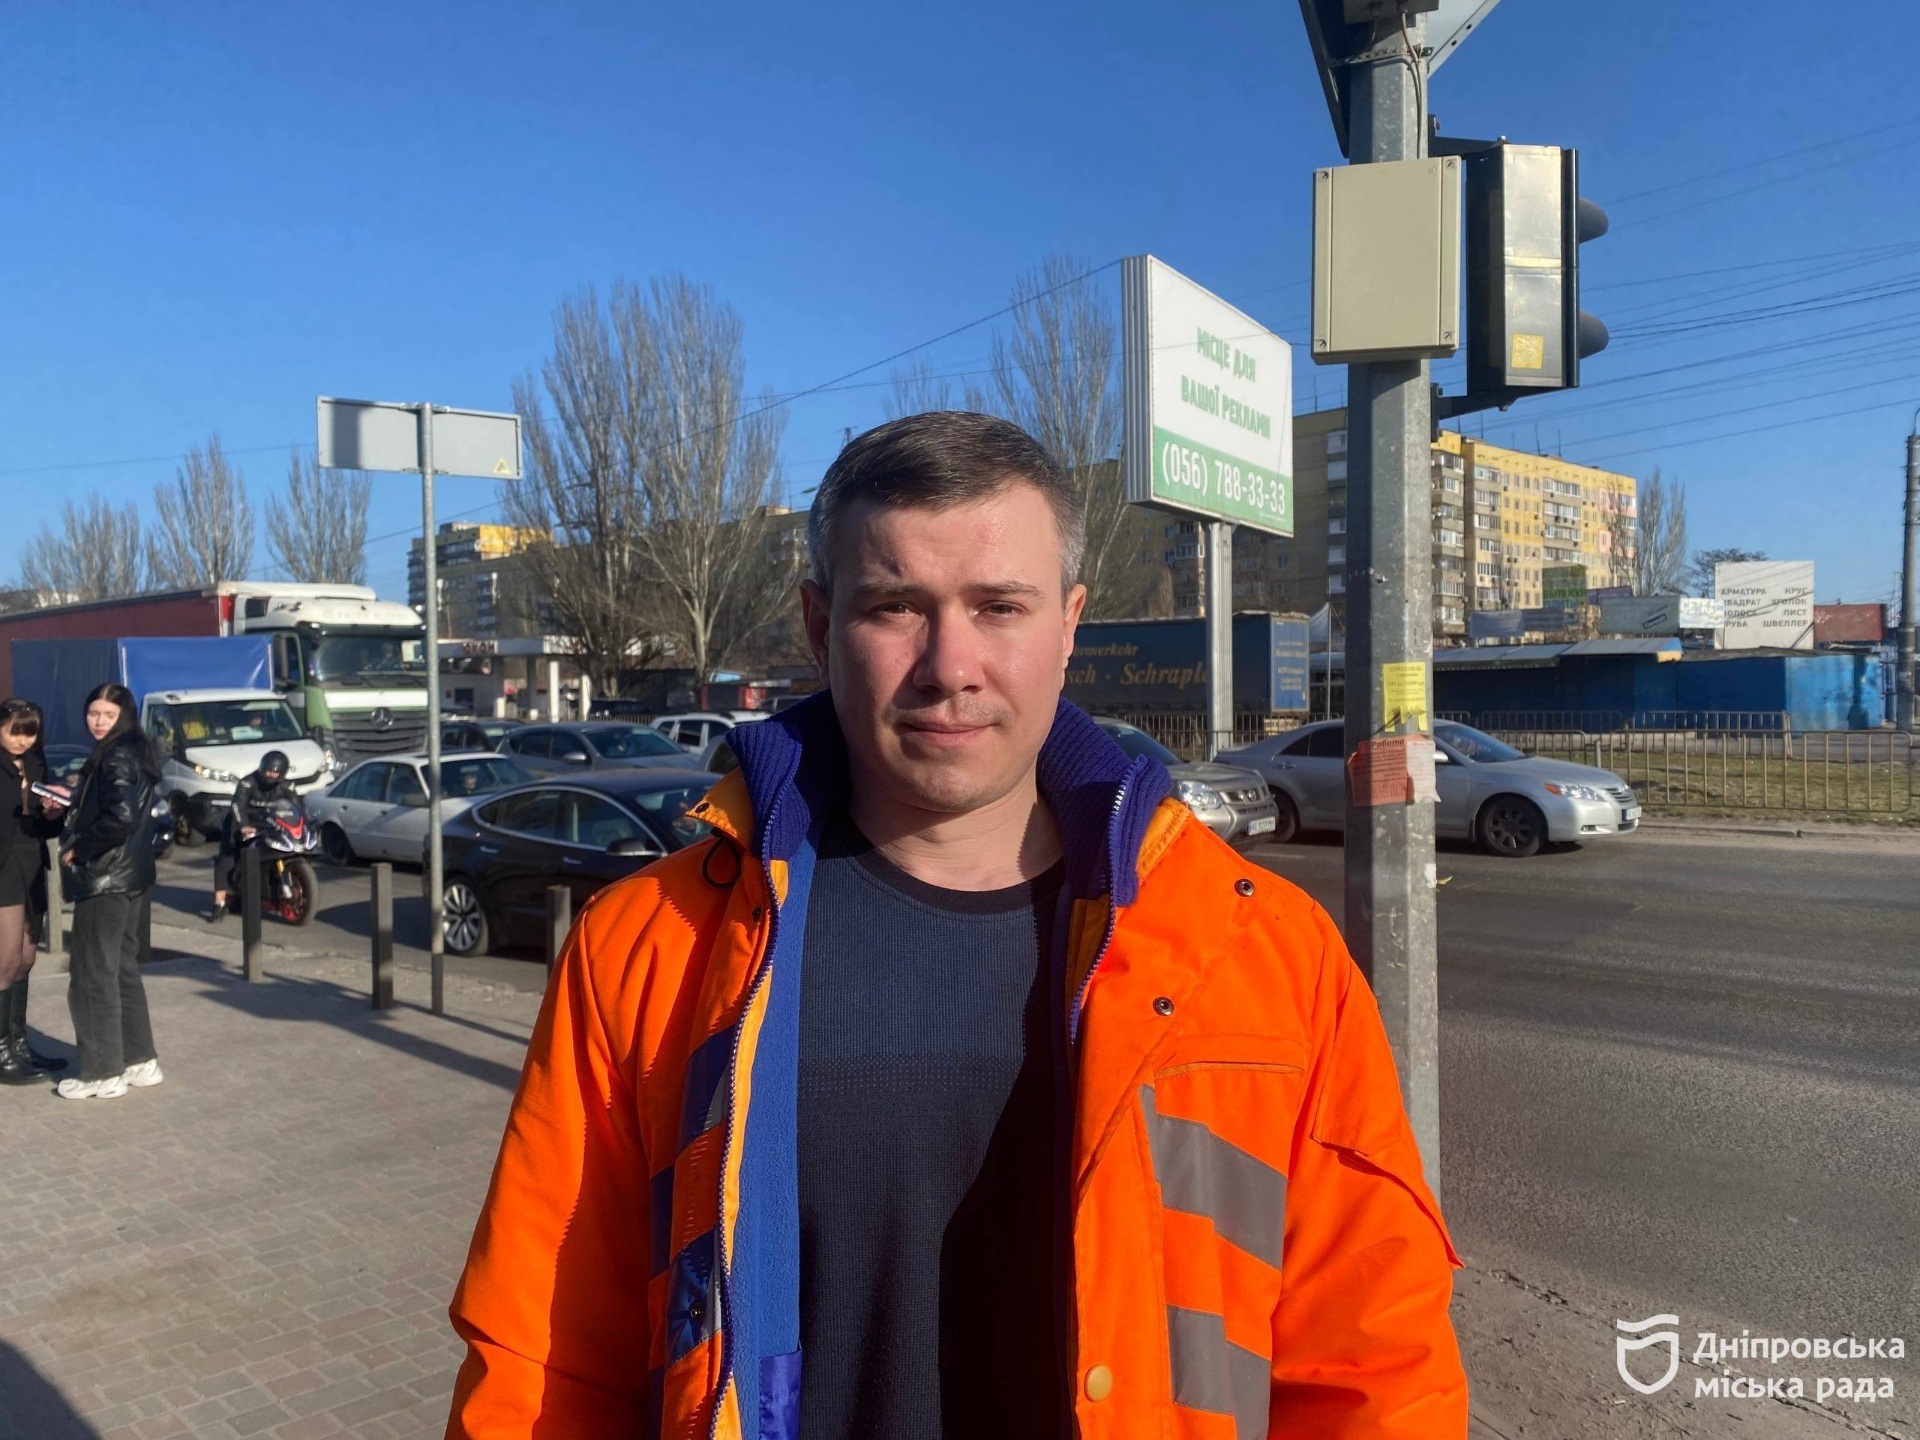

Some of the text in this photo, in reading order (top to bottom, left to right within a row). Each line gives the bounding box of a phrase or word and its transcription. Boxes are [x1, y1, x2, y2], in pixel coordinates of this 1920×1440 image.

[1196, 326, 1257, 382] МІСЦЕ ДЛЯ
[1181, 375, 1271, 439] ВАШОЇ РЕКЛАМИ
[1162, 441, 1286, 516] (056) 788-33-33
[1721, 587, 1767, 595] АРМАТУРА
[1784, 587, 1809, 595] КРУГ
[1782, 608, 1807, 617] ЛИСТ
[1724, 620, 1748, 628] РУБА
[1763, 619, 1809, 628] ШВЕЛЛЕР
[1065, 663, 1096, 684] sch
[1371, 739, 1405, 748] Работа
